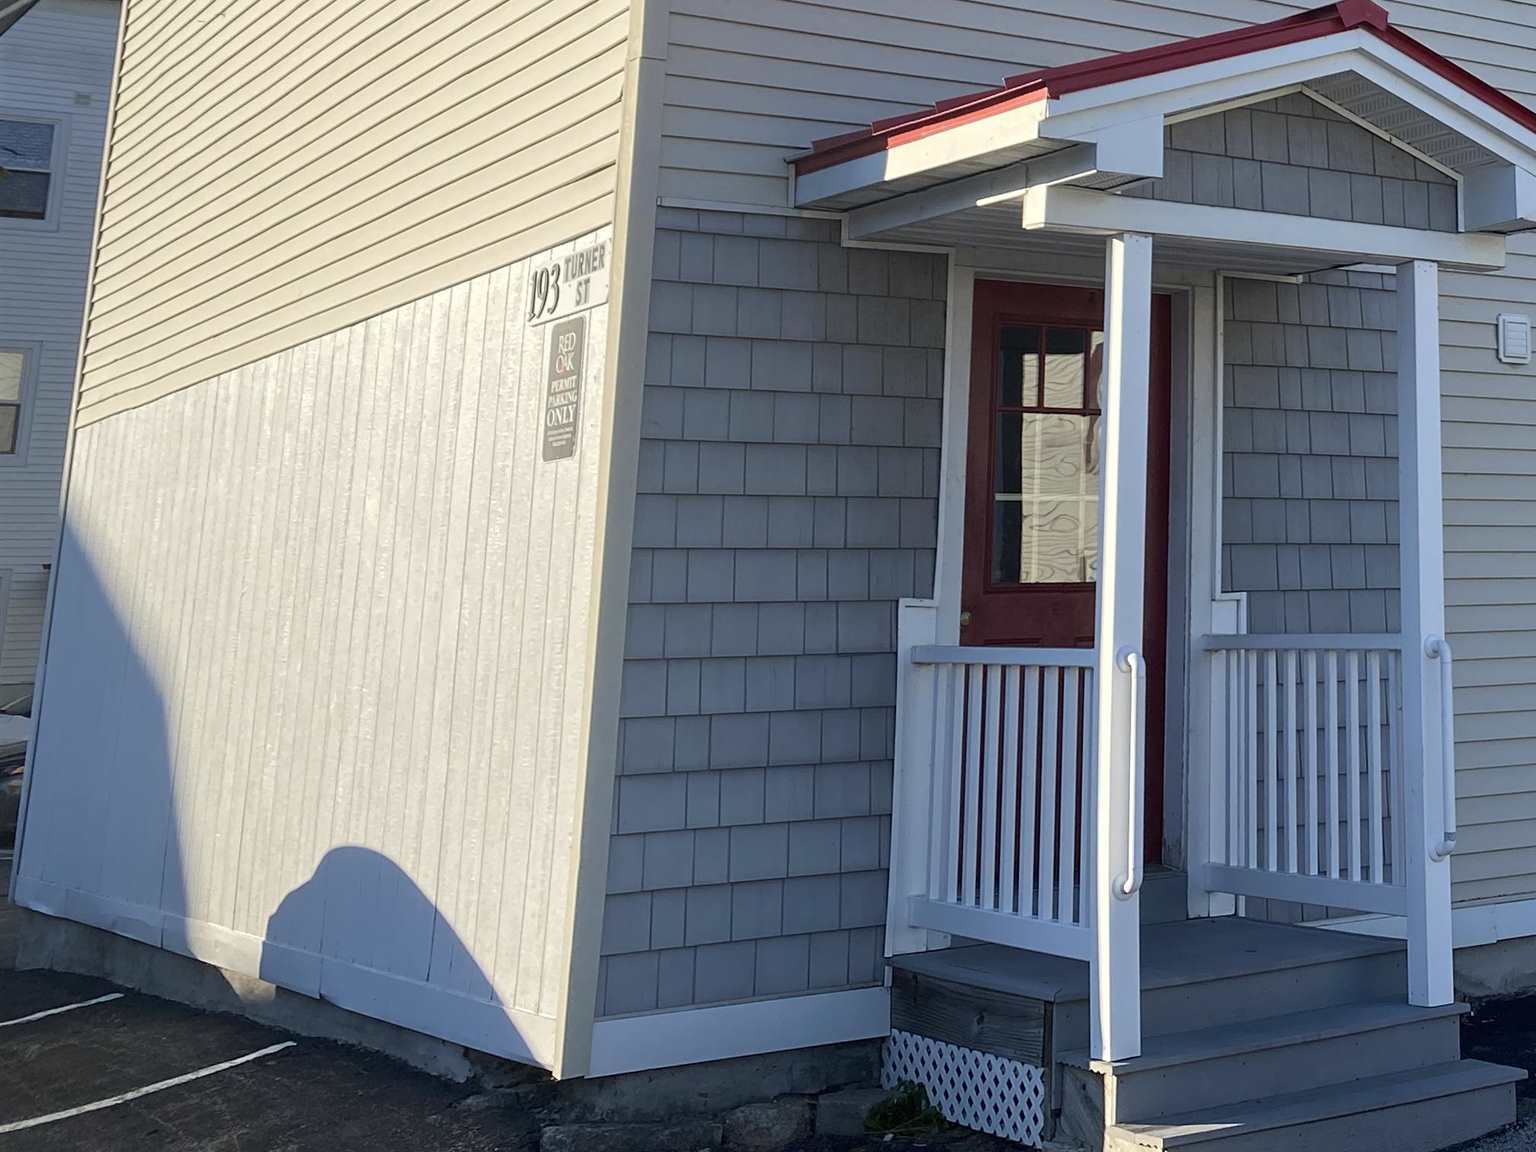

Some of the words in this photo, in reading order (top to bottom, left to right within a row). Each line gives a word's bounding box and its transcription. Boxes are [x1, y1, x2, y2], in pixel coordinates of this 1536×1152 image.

[563, 243, 605, 282] TURNER
[527, 263, 560, 322] 193
[575, 278, 590, 306] ST
[558, 332, 577, 353] RED
[555, 353, 575, 374] OAK
[546, 404, 577, 427] ONLY
